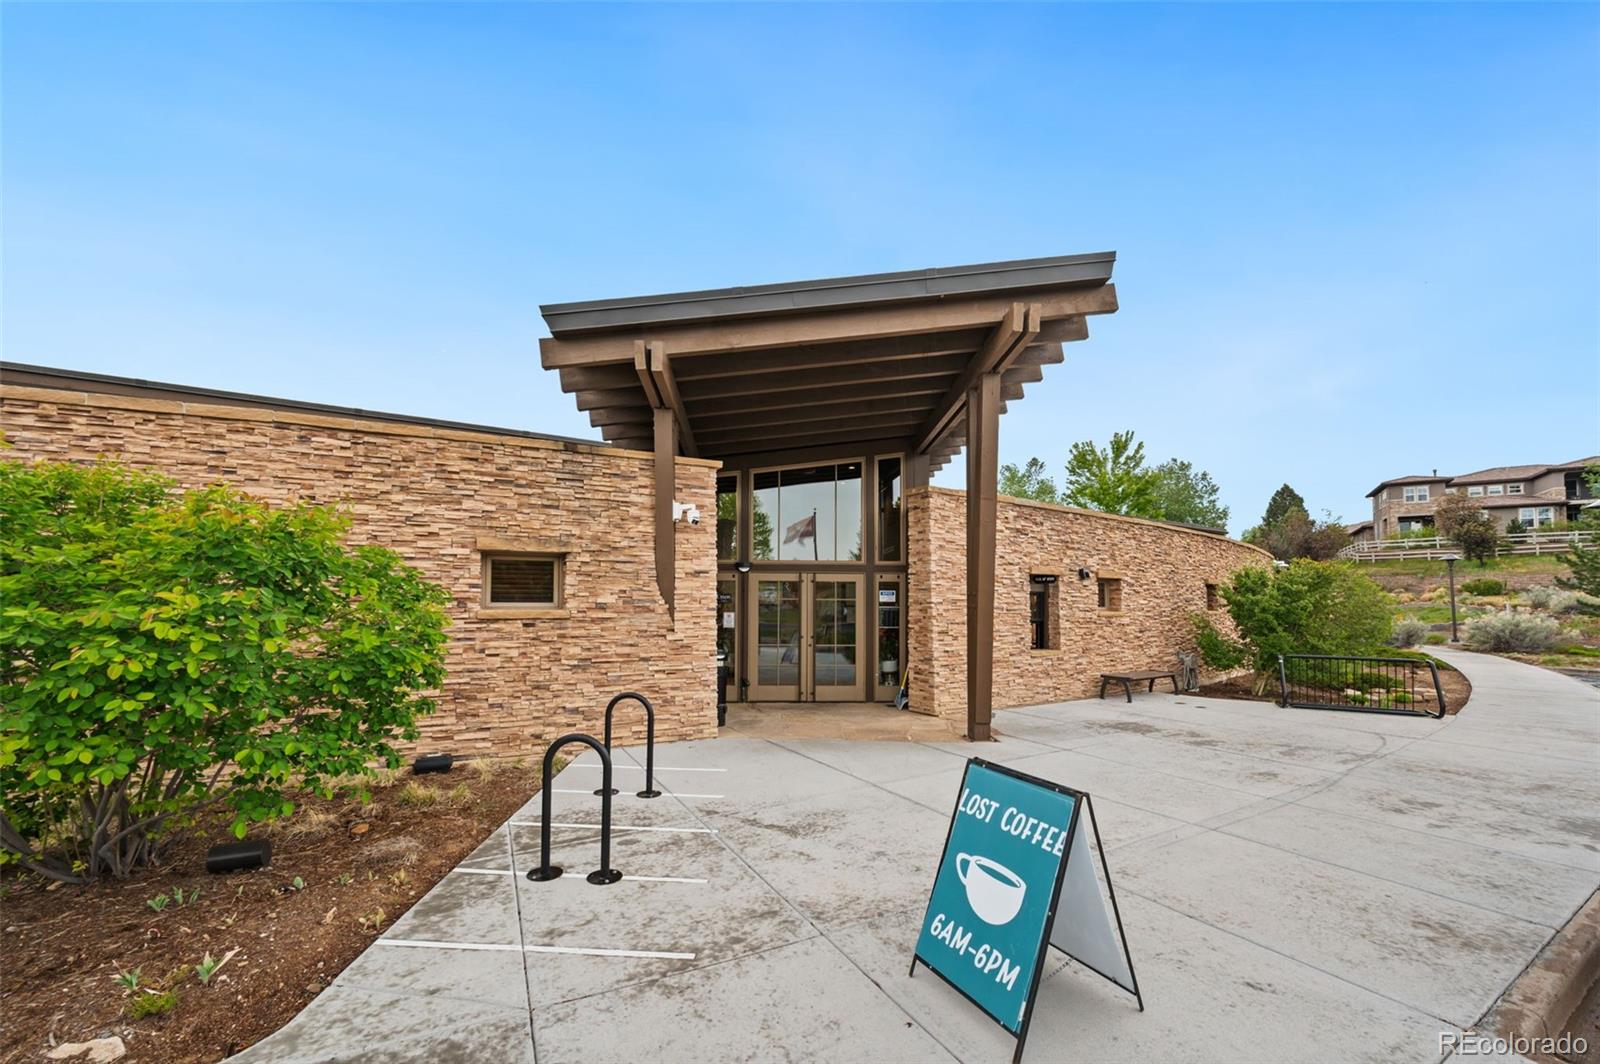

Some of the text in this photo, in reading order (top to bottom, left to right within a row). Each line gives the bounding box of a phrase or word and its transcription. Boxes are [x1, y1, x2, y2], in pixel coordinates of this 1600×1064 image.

[959, 788, 1067, 857] LOST COFFEE
[930, 913, 1021, 991] 6AM-6PM
